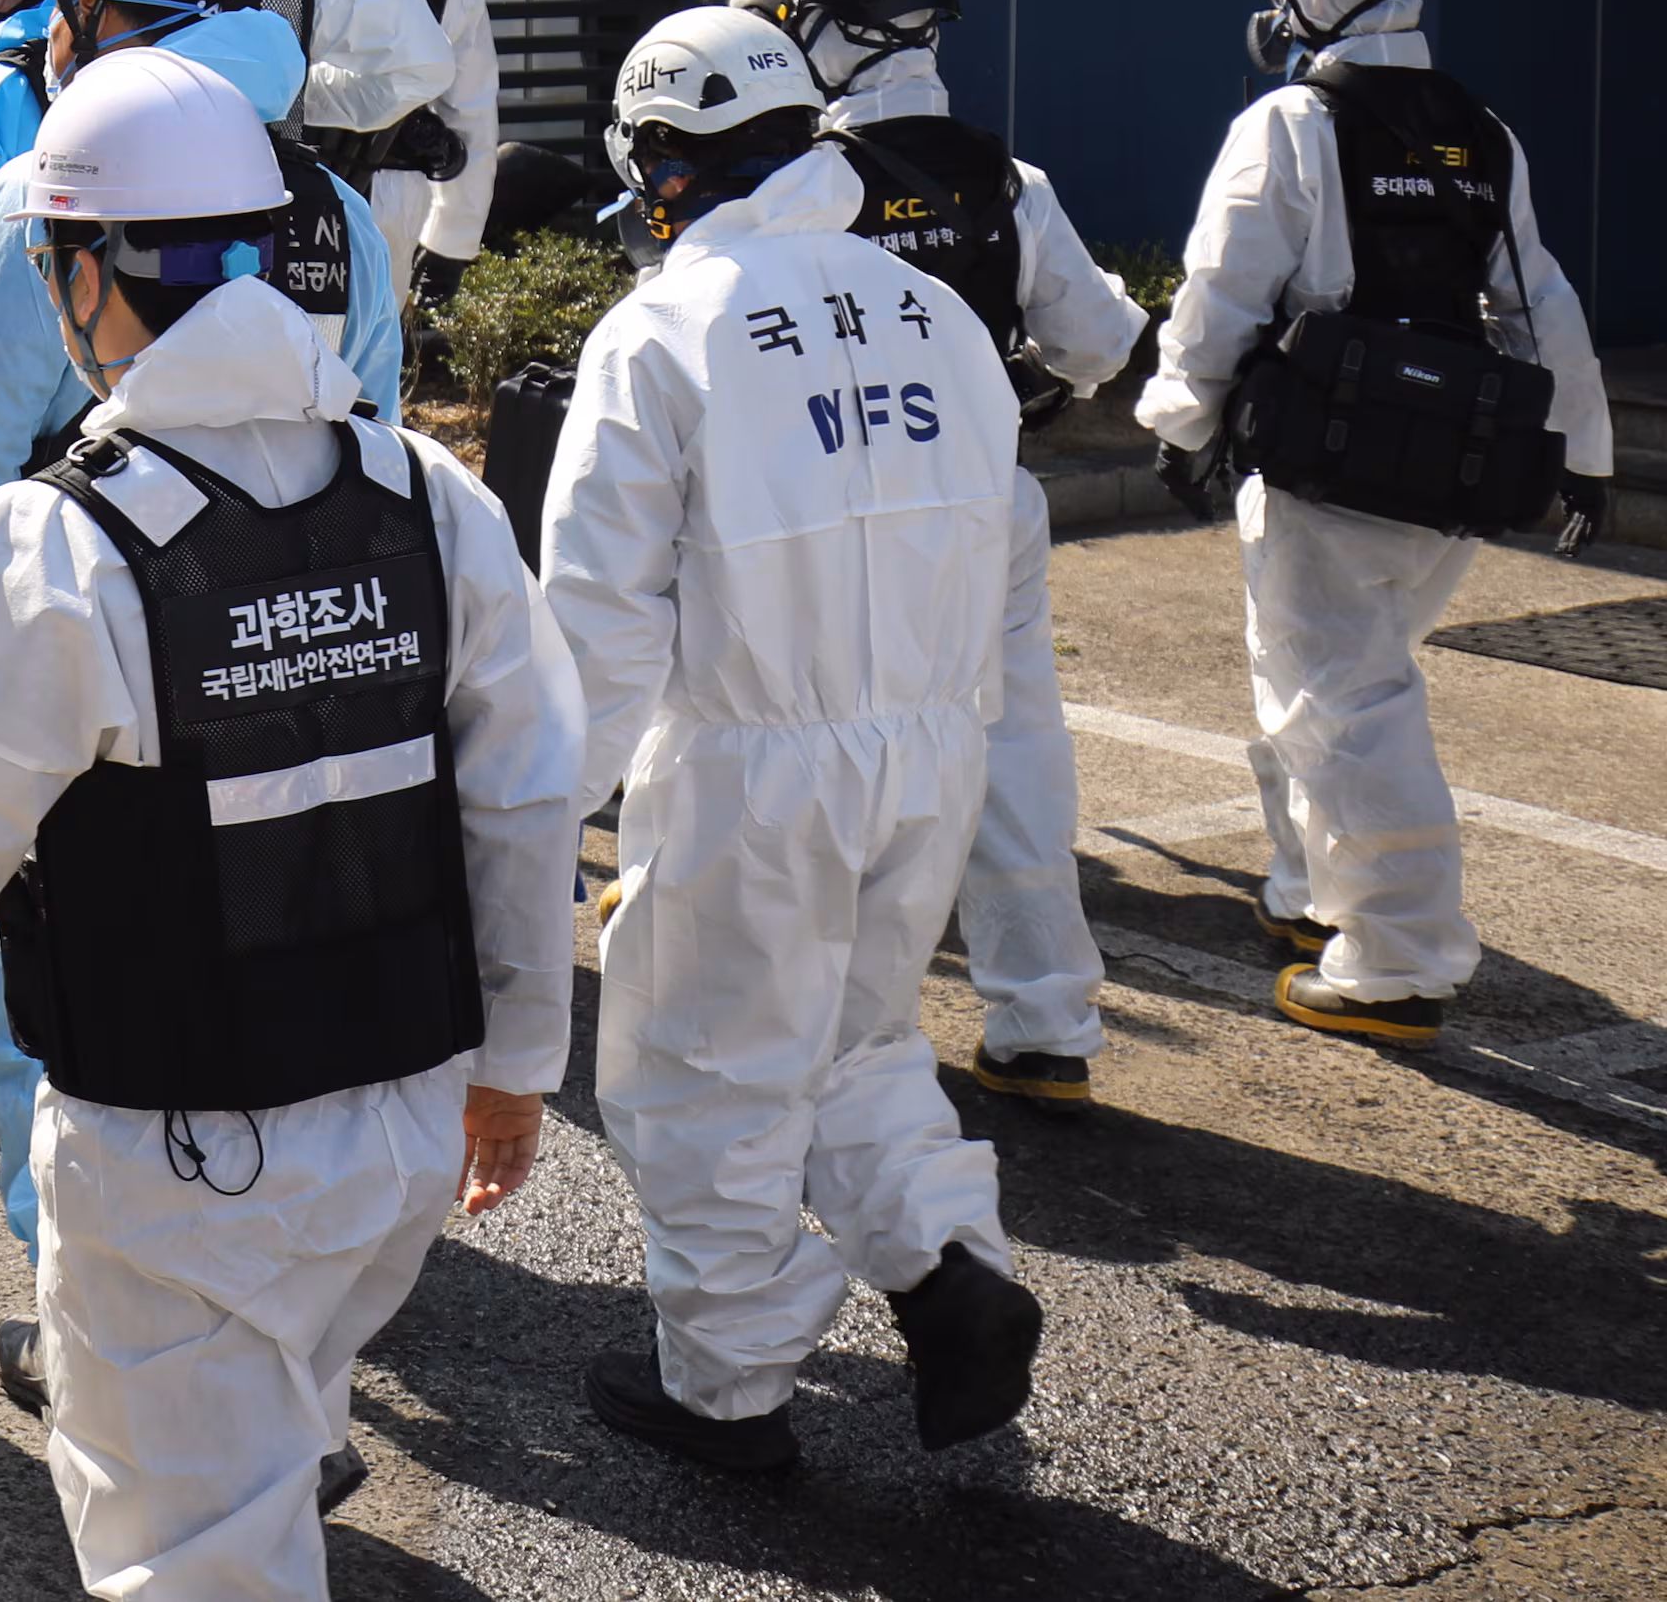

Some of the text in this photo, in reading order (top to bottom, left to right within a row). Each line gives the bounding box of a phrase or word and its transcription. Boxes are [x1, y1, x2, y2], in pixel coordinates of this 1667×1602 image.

[747, 52, 789, 71] NFS
[745, 289, 933, 357] 국과수
[1402, 366, 1441, 383] Nikon
[806, 381, 941, 455] NFS
[228, 576, 388, 651] 과학조사
[200, 631, 421, 701] 국립재난안전연구원
